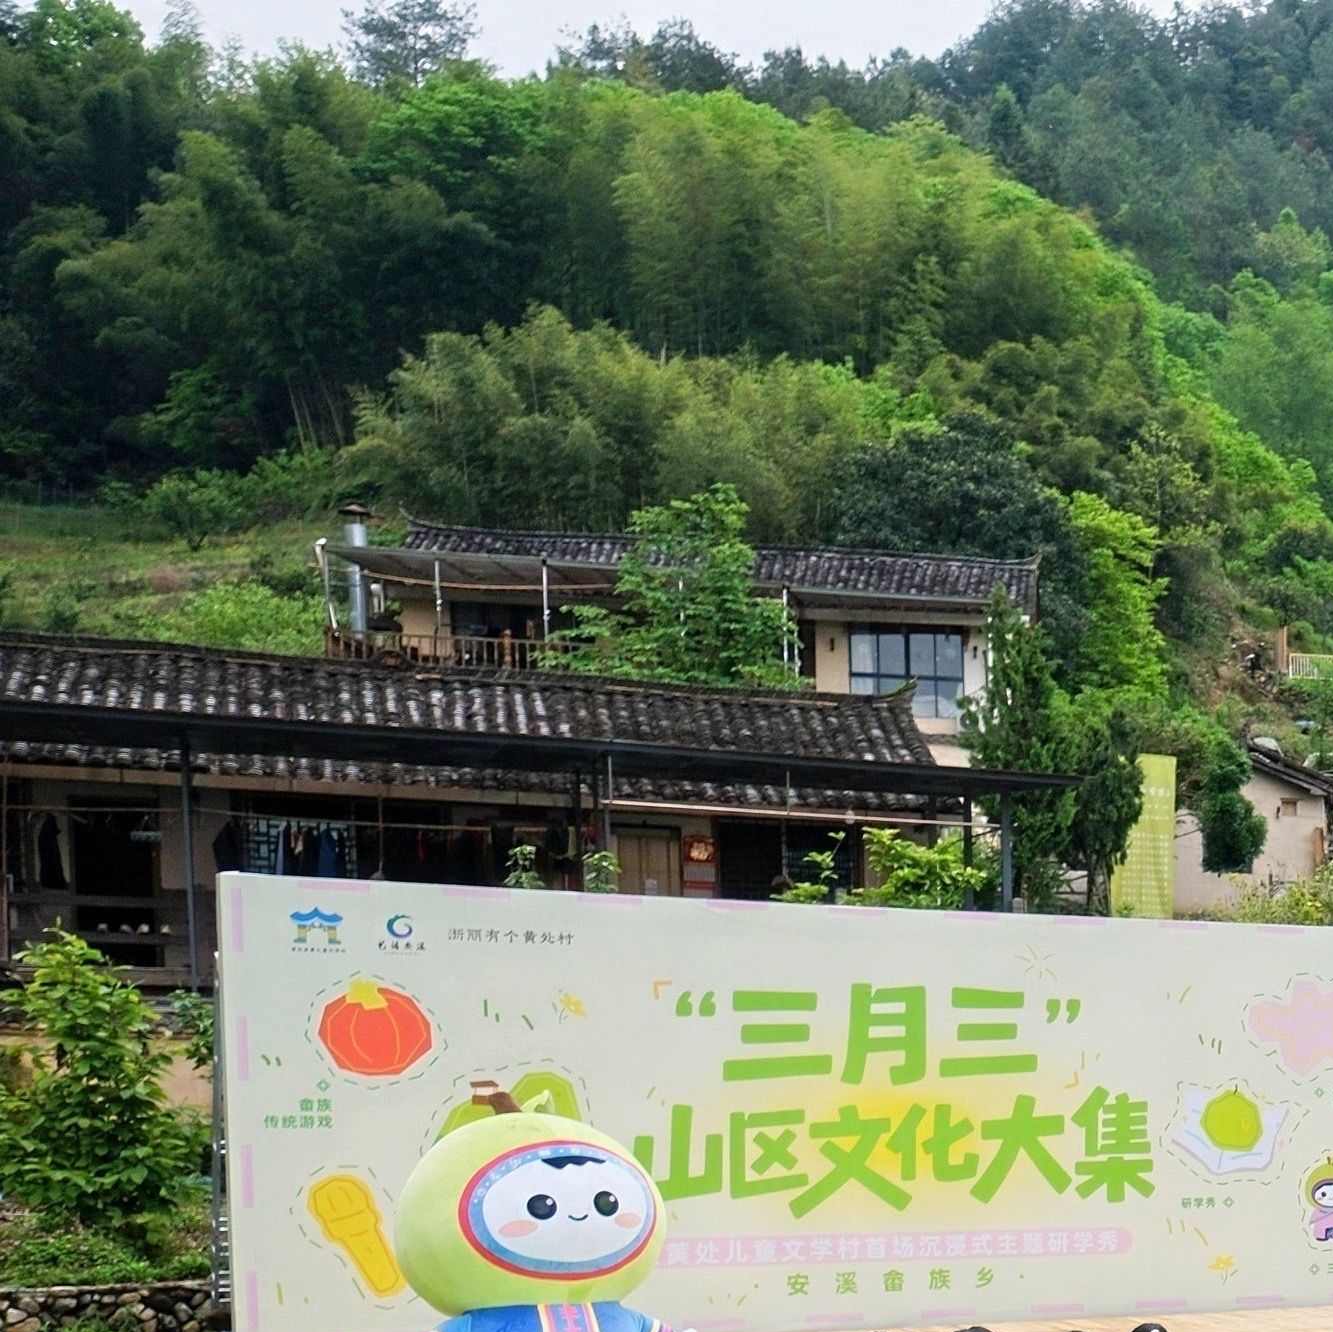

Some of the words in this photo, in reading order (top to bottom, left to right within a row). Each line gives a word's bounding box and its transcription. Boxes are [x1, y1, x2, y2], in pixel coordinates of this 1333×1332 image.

[263, 1115, 333, 1129] 传统游戏
[634, 1086, 1155, 1219] 山区文化大集
[1181, 1197, 1216, 1209] 研学秀
